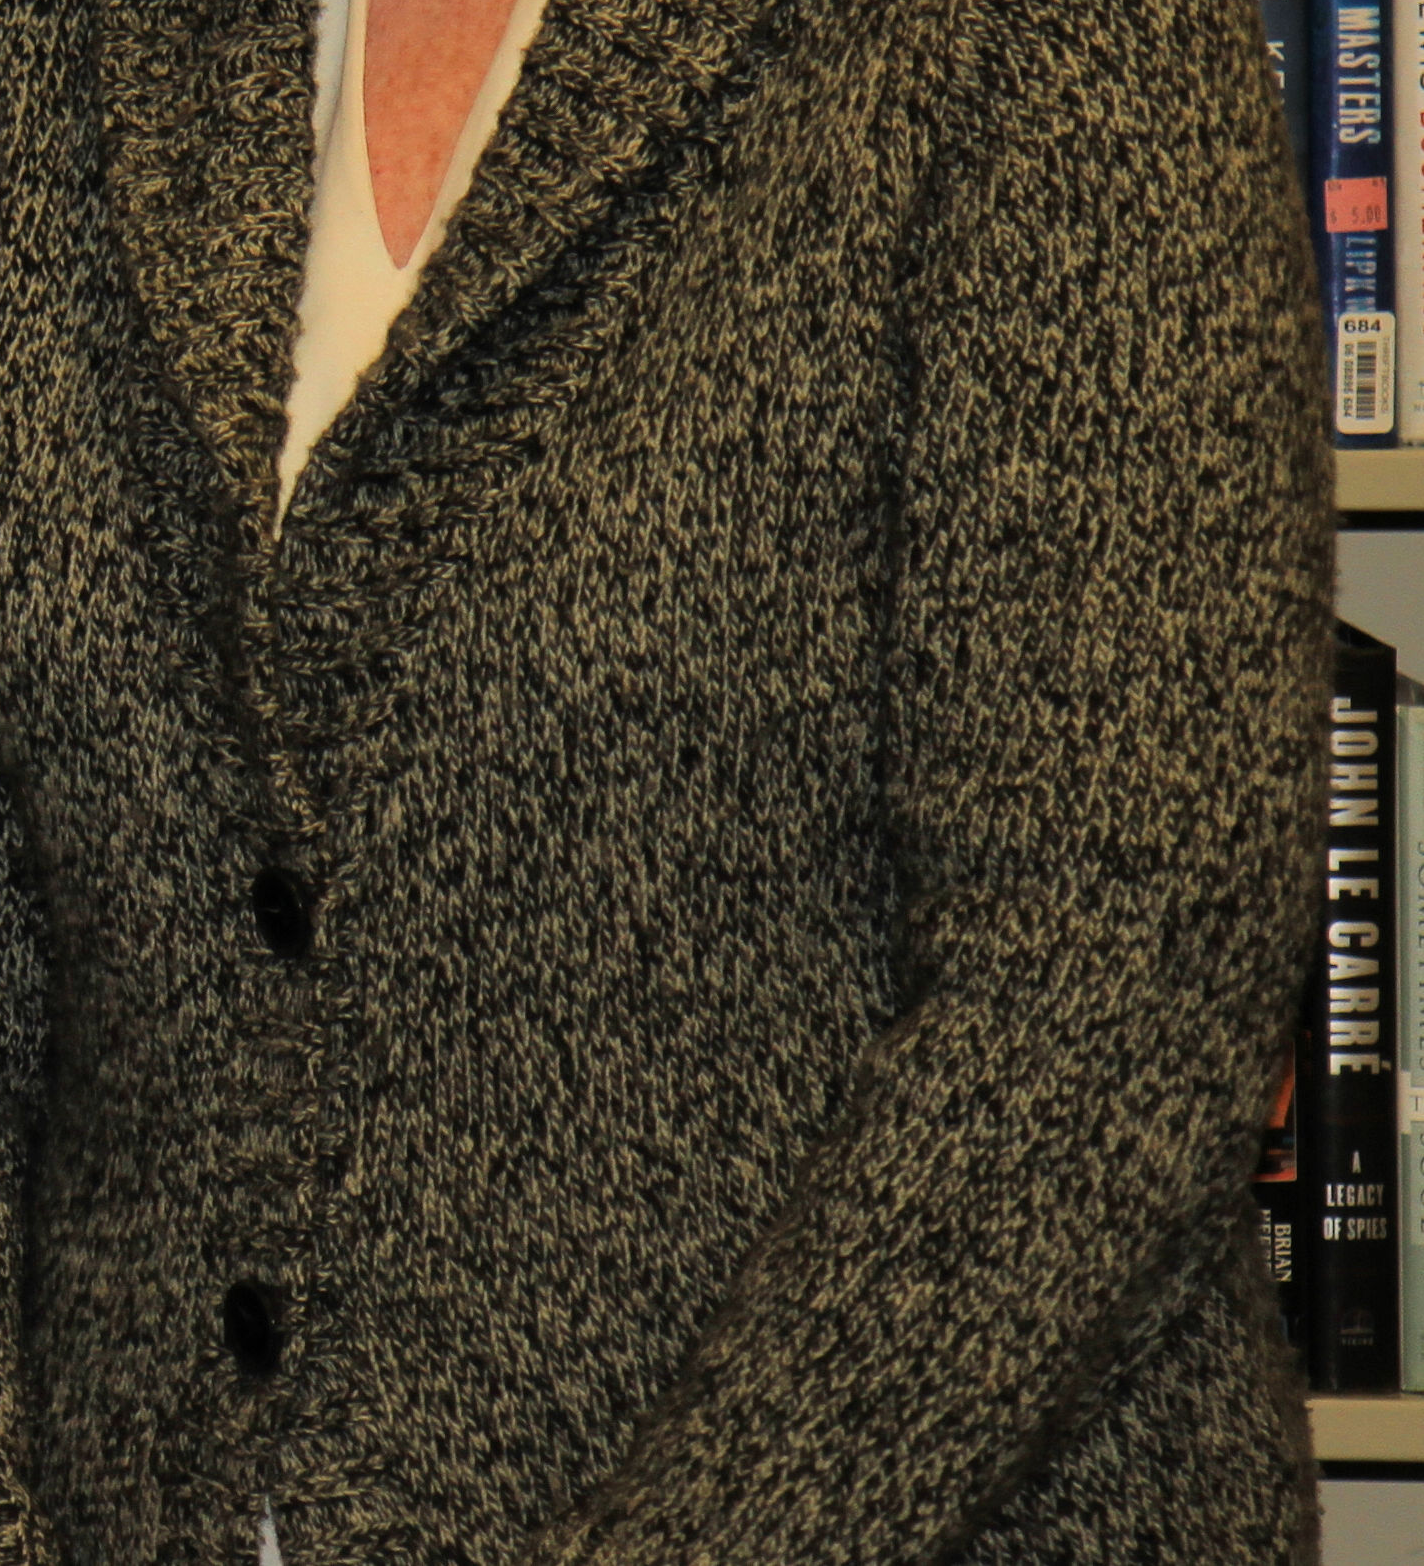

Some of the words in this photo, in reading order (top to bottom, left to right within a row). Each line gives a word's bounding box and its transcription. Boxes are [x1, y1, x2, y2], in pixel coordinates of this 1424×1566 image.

[1336, 6, 1382, 145] MASTERS
[1344, 319, 1381, 333] 684
[1330, 697, 1379, 826] JOHN
[1328, 849, 1379, 900] LE
[1328, 920, 1391, 1076] CARRÉ
[1352, 1150, 1361, 1174] A
[1325, 1183, 1385, 1207] LEGACY
[1274, 1223, 1293, 1282] BRIAN
[1323, 1217, 1340, 1240] OF
[1347, 1217, 1387, 1240] SPIES
